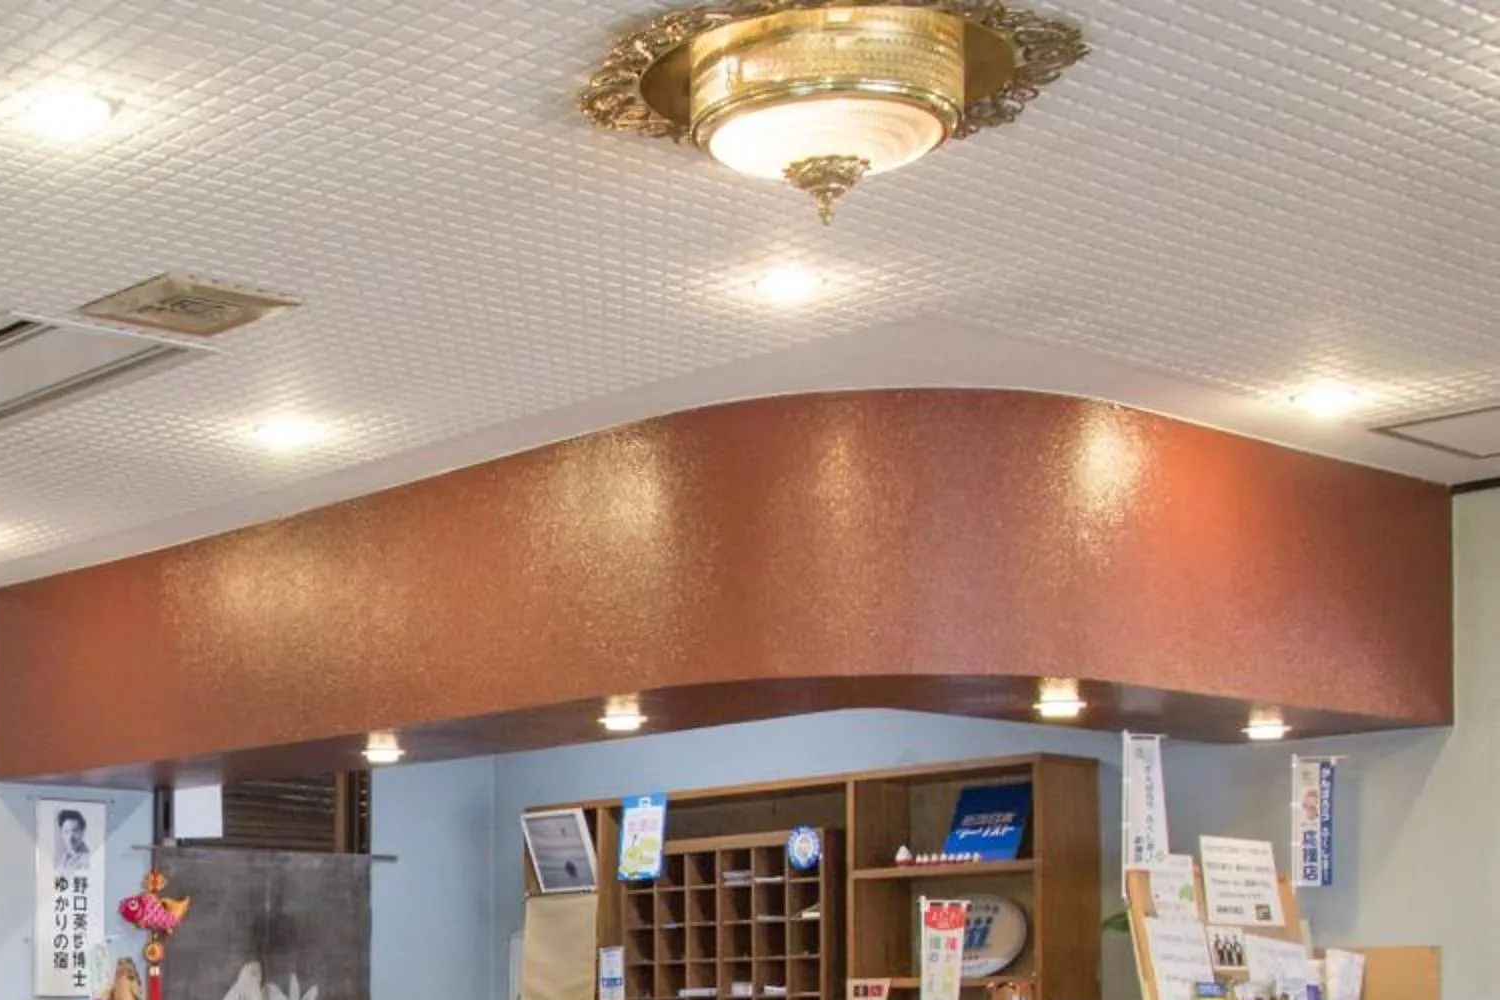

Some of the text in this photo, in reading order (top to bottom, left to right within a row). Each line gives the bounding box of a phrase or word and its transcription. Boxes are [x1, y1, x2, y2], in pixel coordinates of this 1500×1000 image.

[53, 876, 69, 969] ゆかりの宿
[72, 876, 88, 987] 野口英世博士
